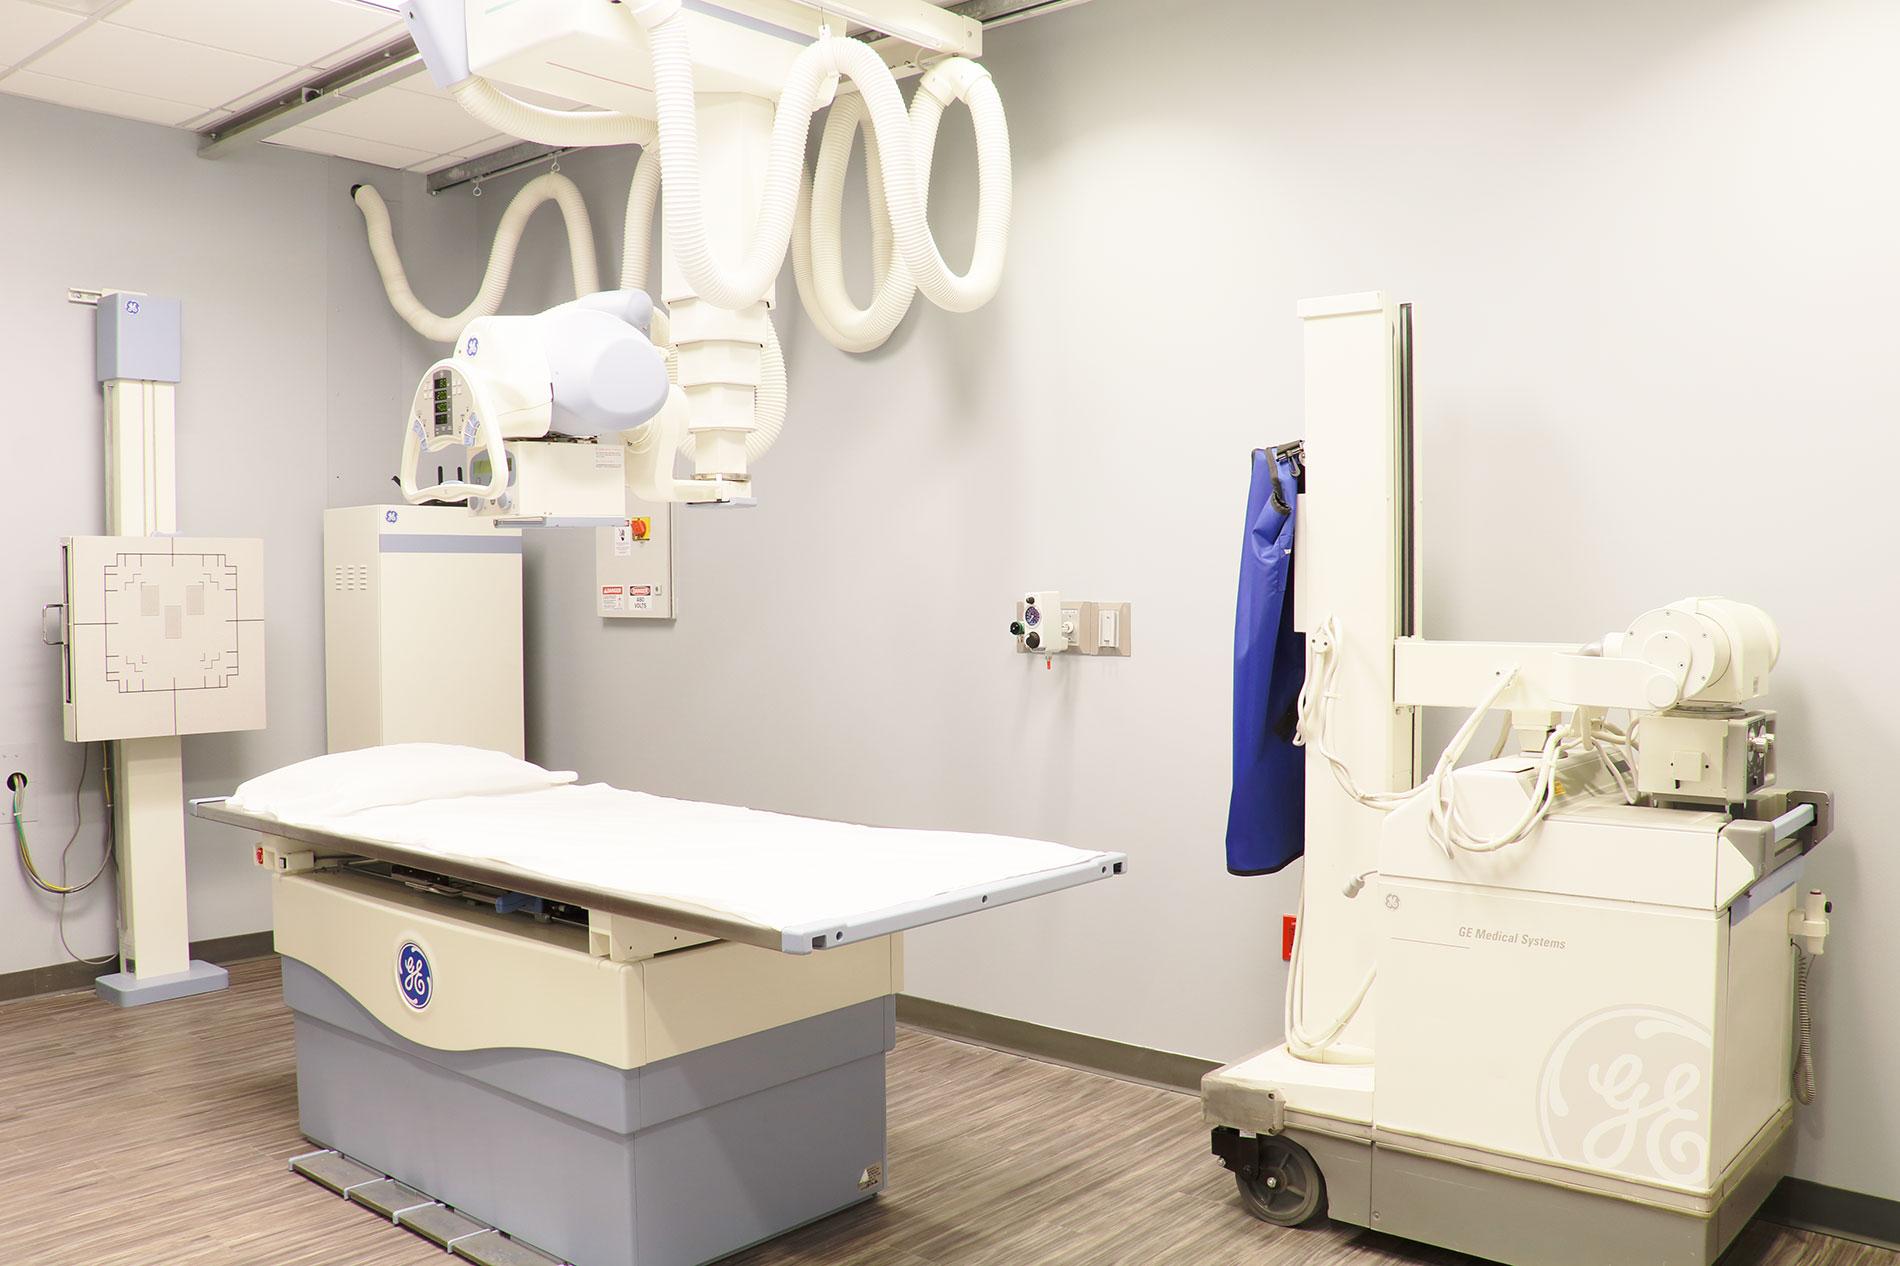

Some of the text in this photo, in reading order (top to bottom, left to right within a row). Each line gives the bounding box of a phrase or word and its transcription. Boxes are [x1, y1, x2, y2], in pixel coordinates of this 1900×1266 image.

[1459, 926, 1566, 949] GE Medical Systems
[1583, 1053, 1708, 1184] GE
